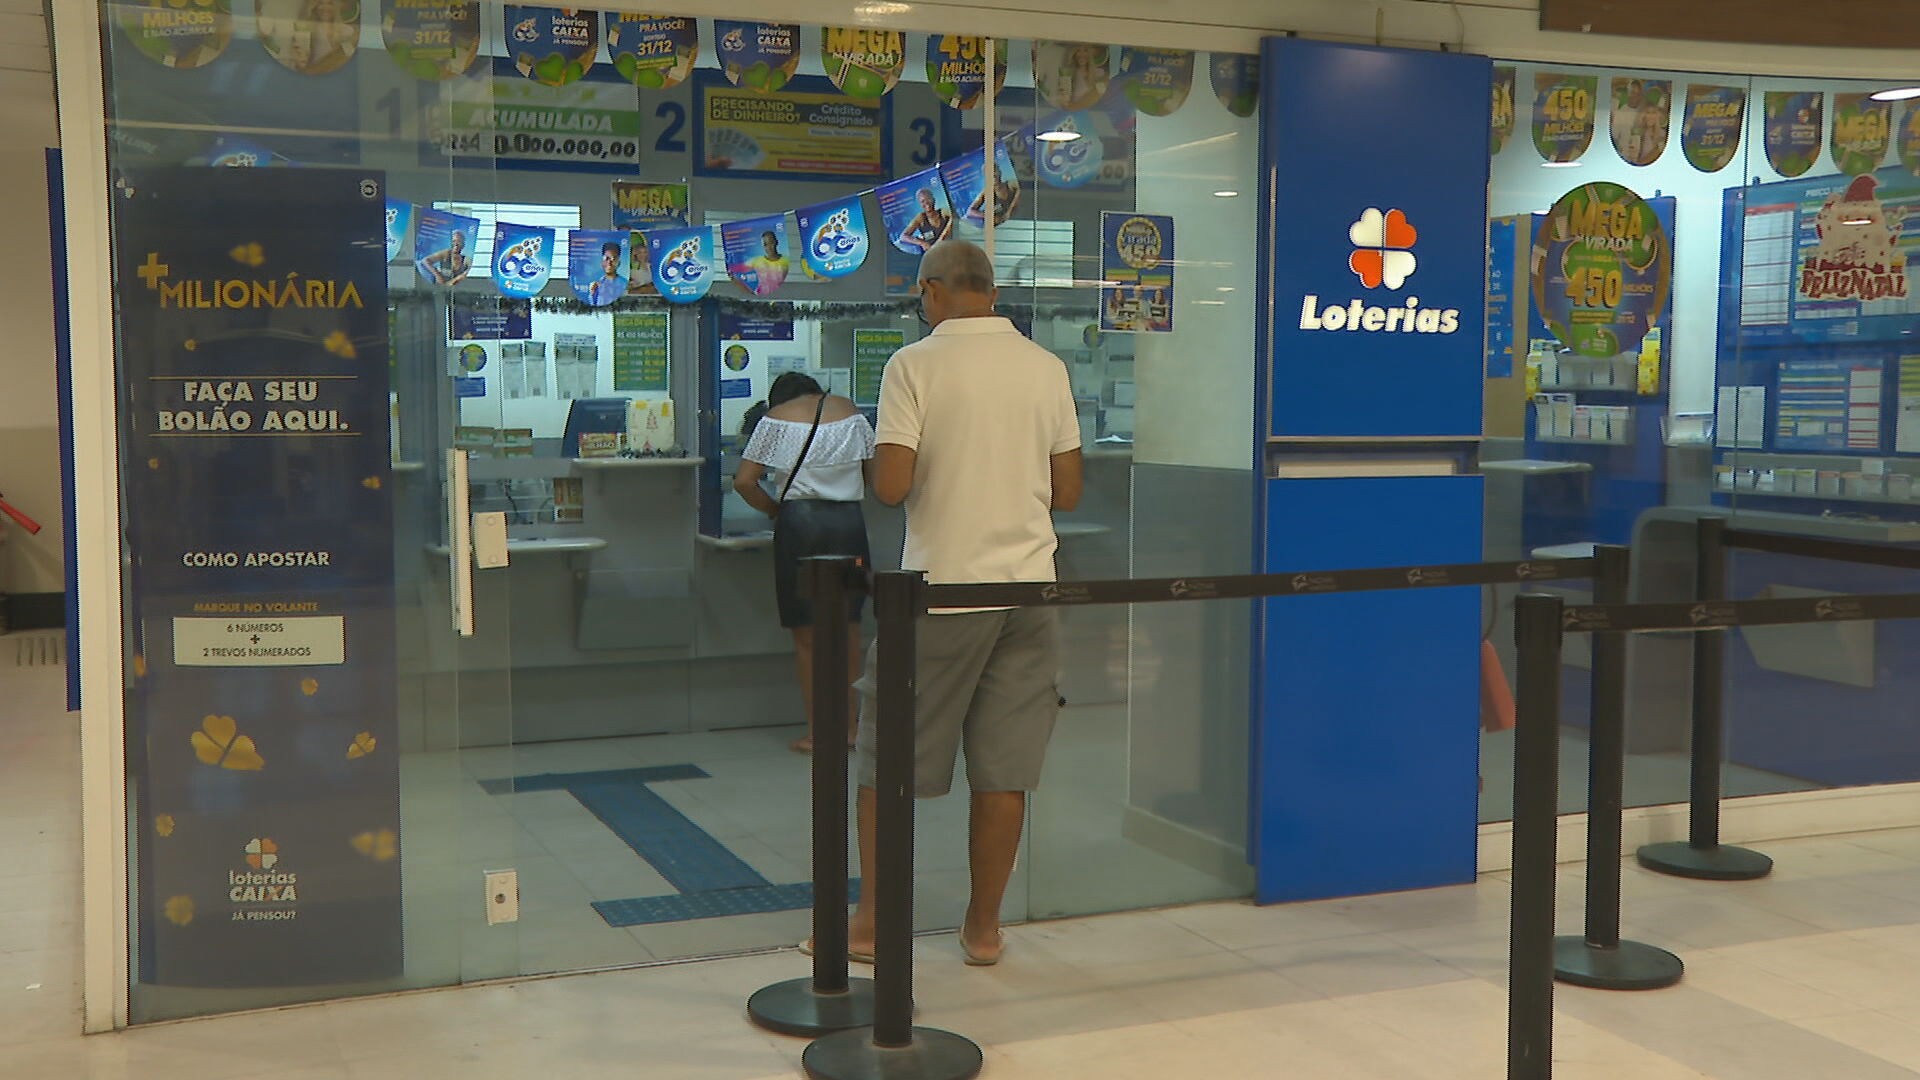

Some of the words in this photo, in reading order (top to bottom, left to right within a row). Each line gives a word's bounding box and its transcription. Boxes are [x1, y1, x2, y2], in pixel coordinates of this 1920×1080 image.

[551, 15, 588, 27] loterias
[551, 26, 588, 37] CAIXA
[637, 40, 673, 56] 31/12
[757, 36, 791, 47] CAIXA
[827, 26, 902, 54] MEGA
[711, 96, 796, 112] PRECISANDO
[820, 102, 862, 116] Crédito
[1543, 89, 1587, 121] 450
[468, 108, 614, 132] ACUMULADA
[712, 109, 731, 121] DE
[808, 112, 874, 127] Consignado
[655, 101, 686, 152] 2
[909, 117, 936, 165] 3
[618, 188, 674, 210] MEGA
[1570, 198, 1642, 240] MEGA
[1584, 236, 1633, 251] VIRADA
[1565, 267, 1623, 308] 450
[1299, 294, 1461, 334] Loterias
[183, 381, 255, 407] FAÇA
[264, 381, 319, 401] SEU
[159, 405, 252, 432] BOLÃO
[263, 410, 349, 432] AQUI.
[183, 551, 239, 567] COMO
[244, 551, 330, 567] APOSTAR
[194, 602, 241, 613] MARQUE
[244, 602, 262, 613] NO
[265, 602, 319, 612] VOLANTE
[227, 623, 233, 632] 6
[235, 621, 284, 633] NÚMEROS
[203, 647, 209, 657] 2
[211, 647, 246, 657] TREVOS
[248, 646, 311, 657] NUMERADOS
[229, 869, 297, 885] loterias
[229, 884, 298, 902] CAIXA
[232, 908, 245, 920] JÁ
[247, 909, 297, 920] PENSOU?
